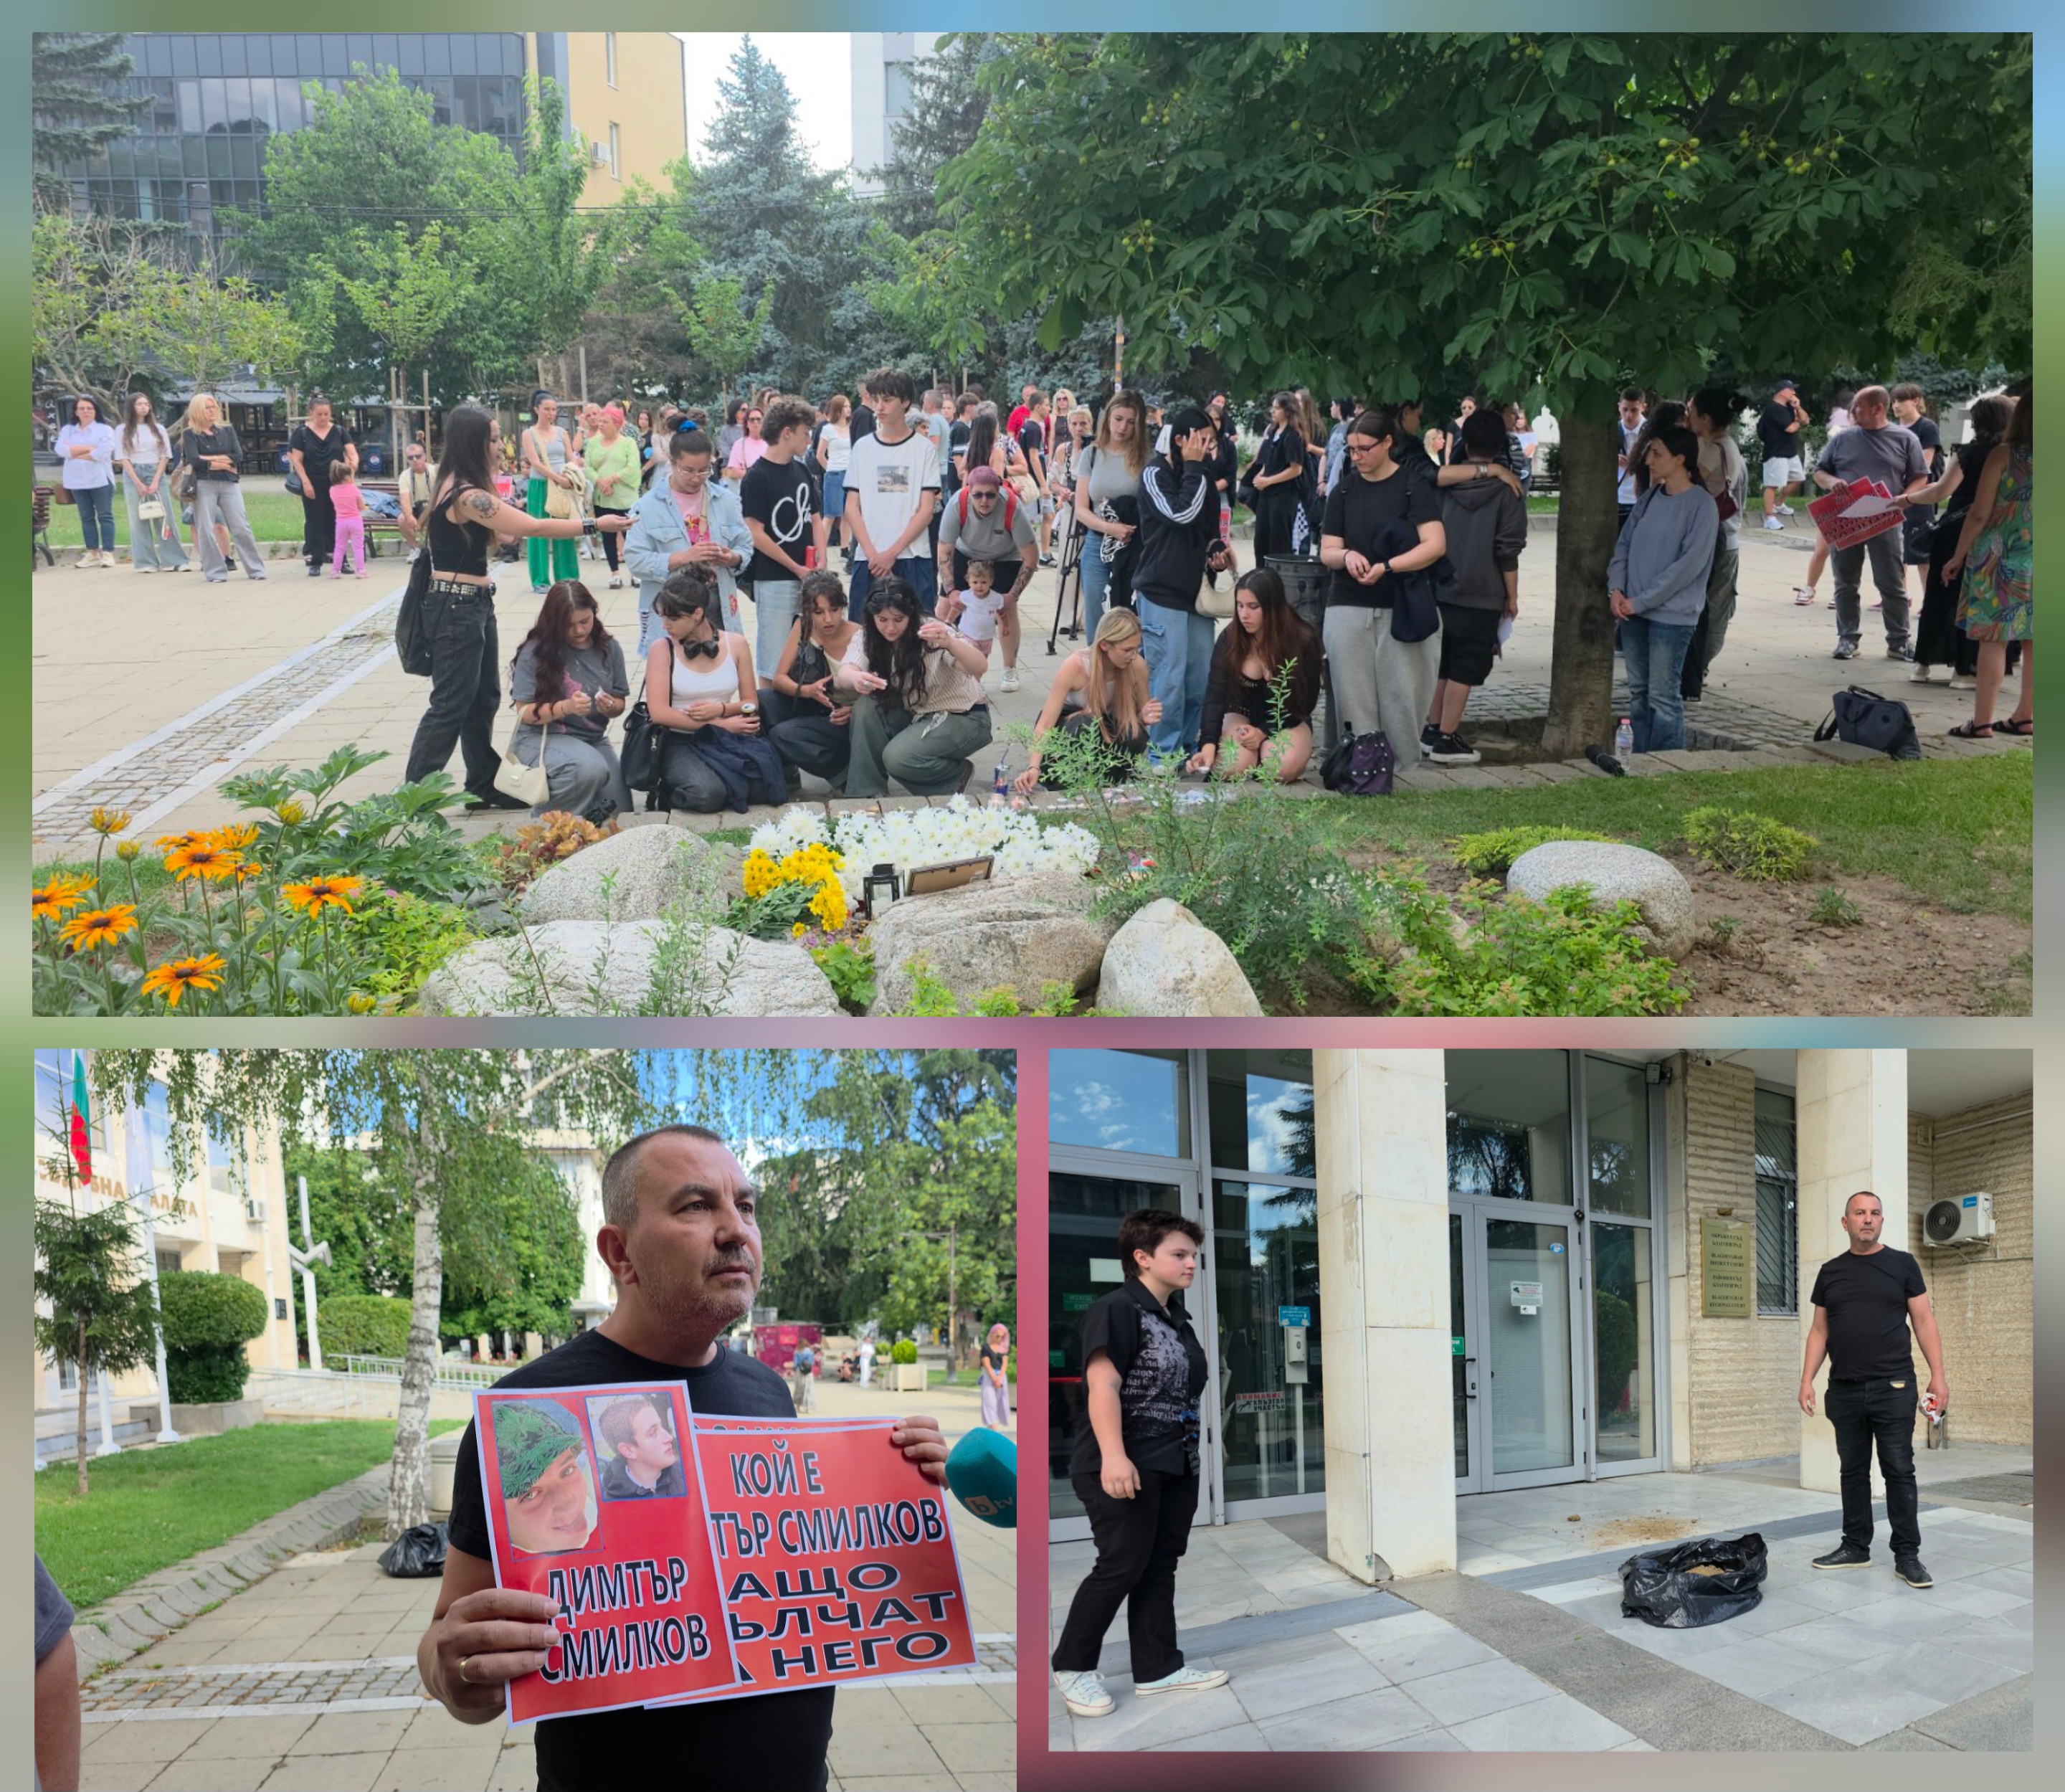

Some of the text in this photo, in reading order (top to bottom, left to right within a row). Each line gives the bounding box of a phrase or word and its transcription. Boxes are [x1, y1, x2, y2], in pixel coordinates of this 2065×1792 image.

[1236, 1391, 1285, 1400] ВНИМАНИЕ!
[729, 1438, 825, 1497] КОЙ Е
[710, 1497, 946, 1559] ТЪР СМИЛКОВ
[547, 1556, 688, 1628] ДИМТЪР
[726, 1562, 901, 1603] АЩО
[729, 1590, 956, 1641] ЪЛЧАТ
[769, 1631, 951, 1679] НЕГО
